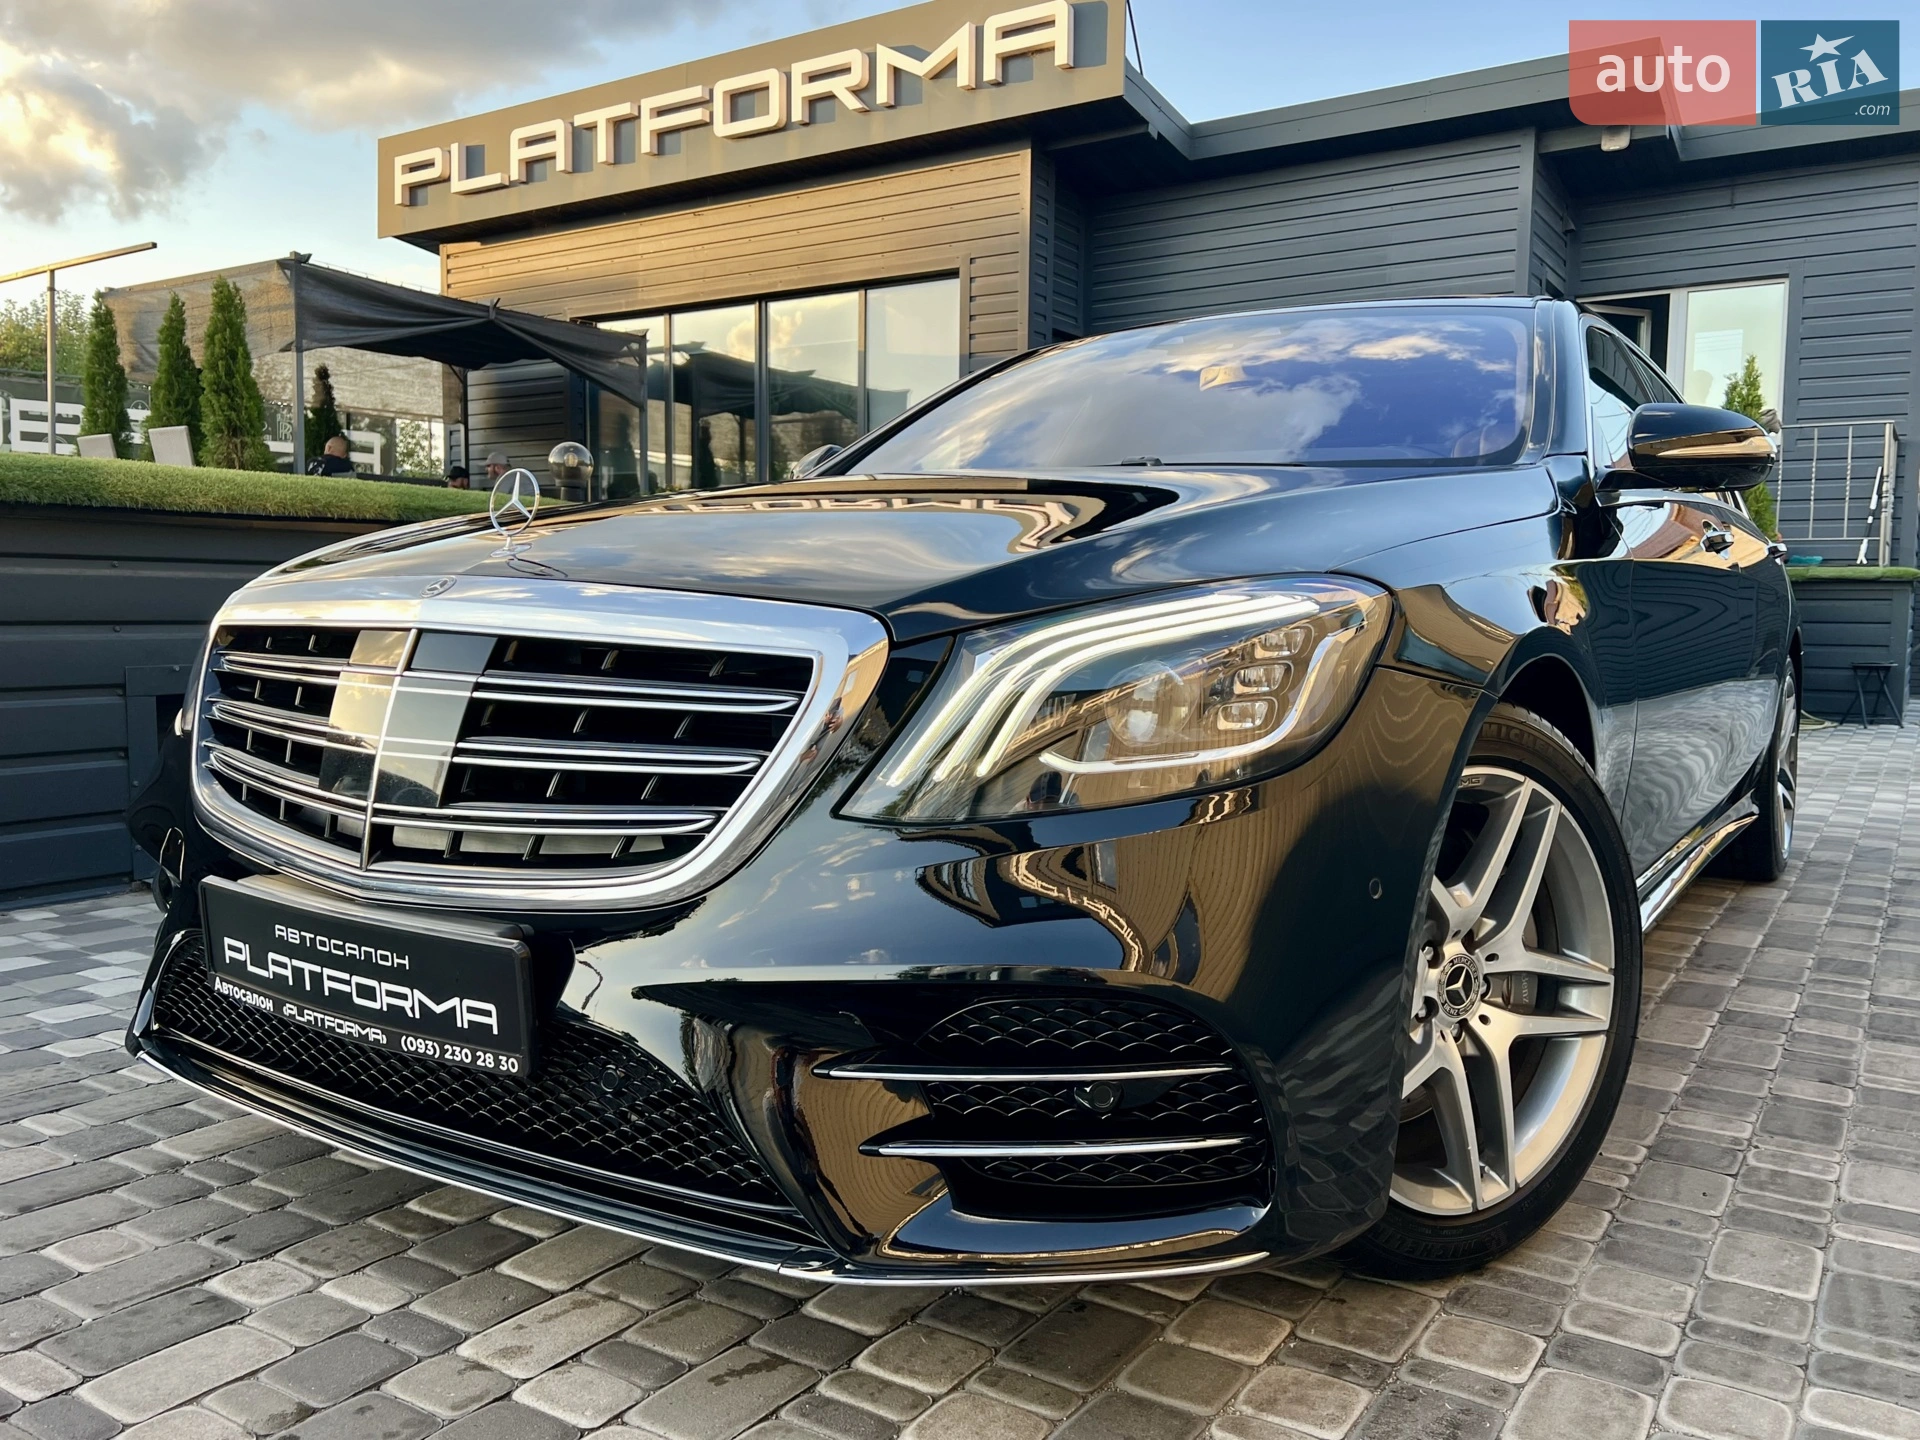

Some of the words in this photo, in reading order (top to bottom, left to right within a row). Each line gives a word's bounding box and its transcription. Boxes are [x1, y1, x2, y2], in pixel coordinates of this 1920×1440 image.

[395, 0, 1075, 207] PLATFORMA
[1460, 777, 1481, 786] MG
[224, 937, 498, 1035] PLATFORMA
[275, 924, 409, 970] АВТОСАЛОН
[214, 977, 274, 1012] Автосалон
[401, 1035, 440, 1059] (093)
[444, 1044, 472, 1064] 230
[477, 1052, 495, 1068] 28
[499, 1055, 519, 1073] 30
